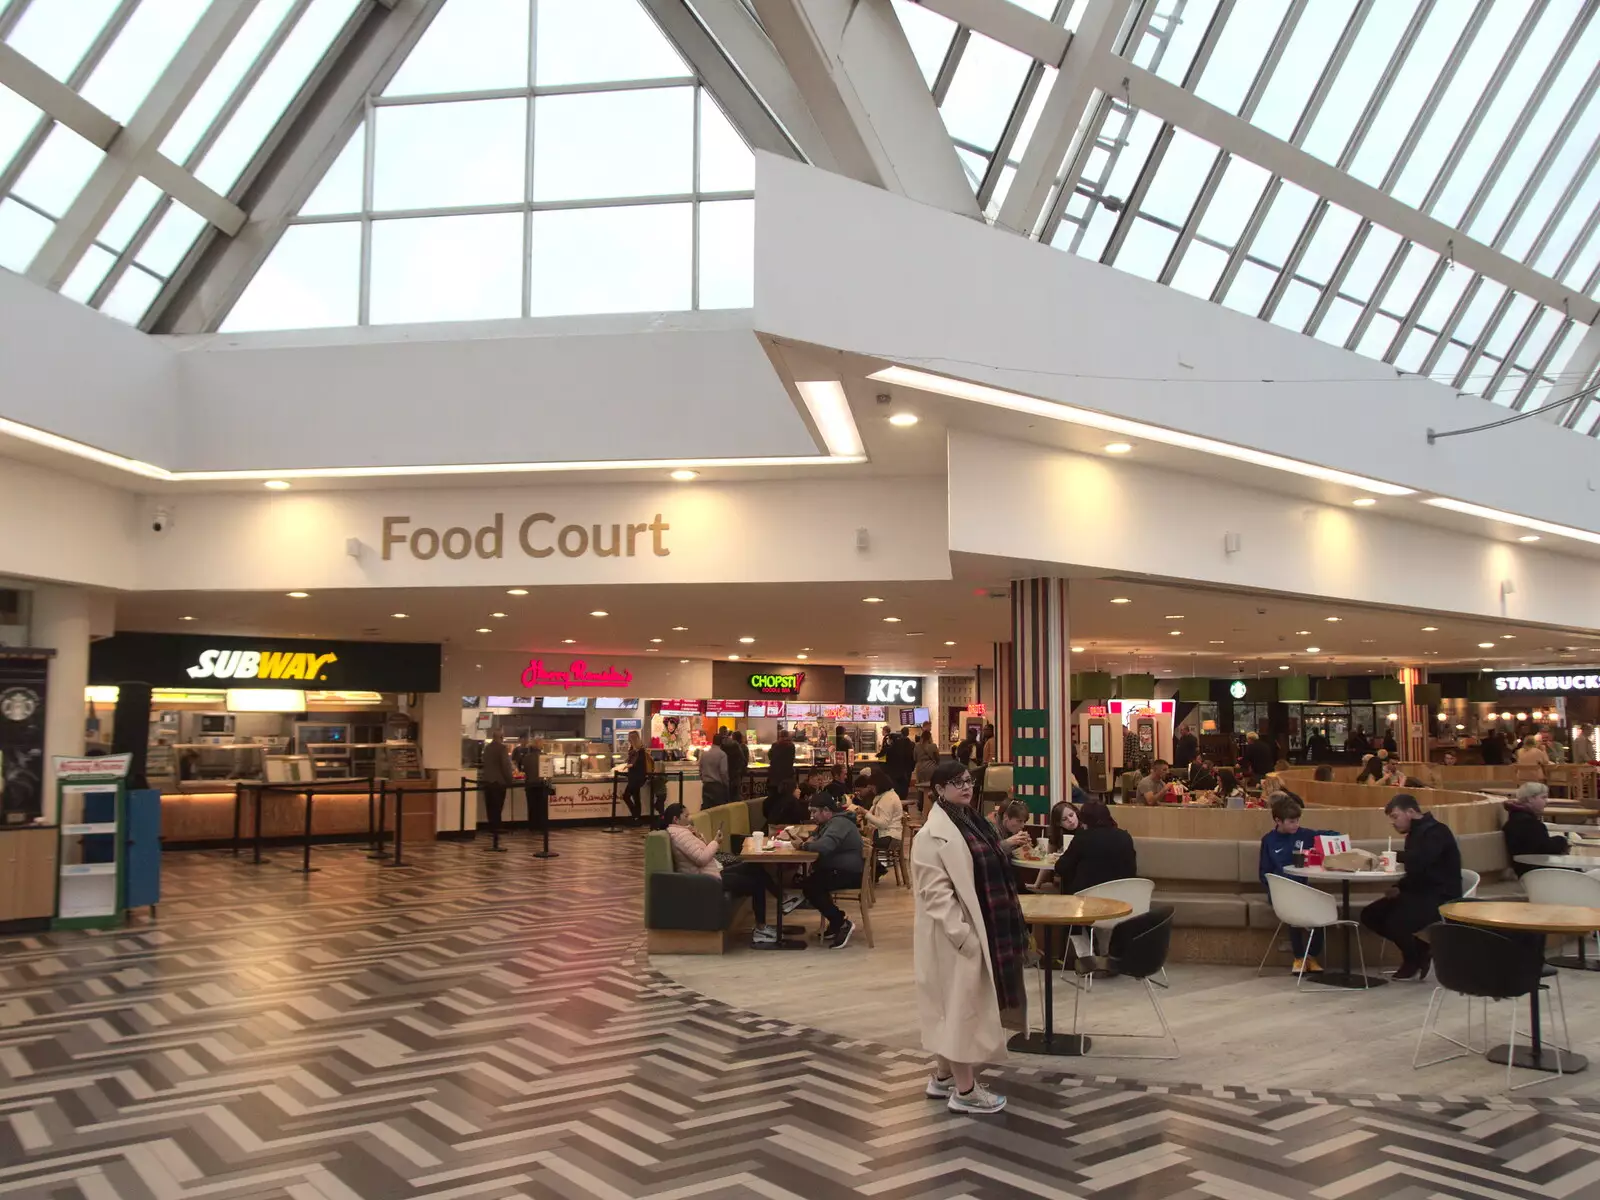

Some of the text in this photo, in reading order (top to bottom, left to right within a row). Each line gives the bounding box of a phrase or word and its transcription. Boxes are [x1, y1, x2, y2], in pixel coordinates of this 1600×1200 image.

[382, 512, 670, 561] Food Court
[186, 649, 338, 680] SUBWAY
[521, 659, 570, 690] Harry
[866, 679, 917, 702] KFC
[1495, 675, 1600, 691] STARBUCK
[550, 795, 574, 808] arry
